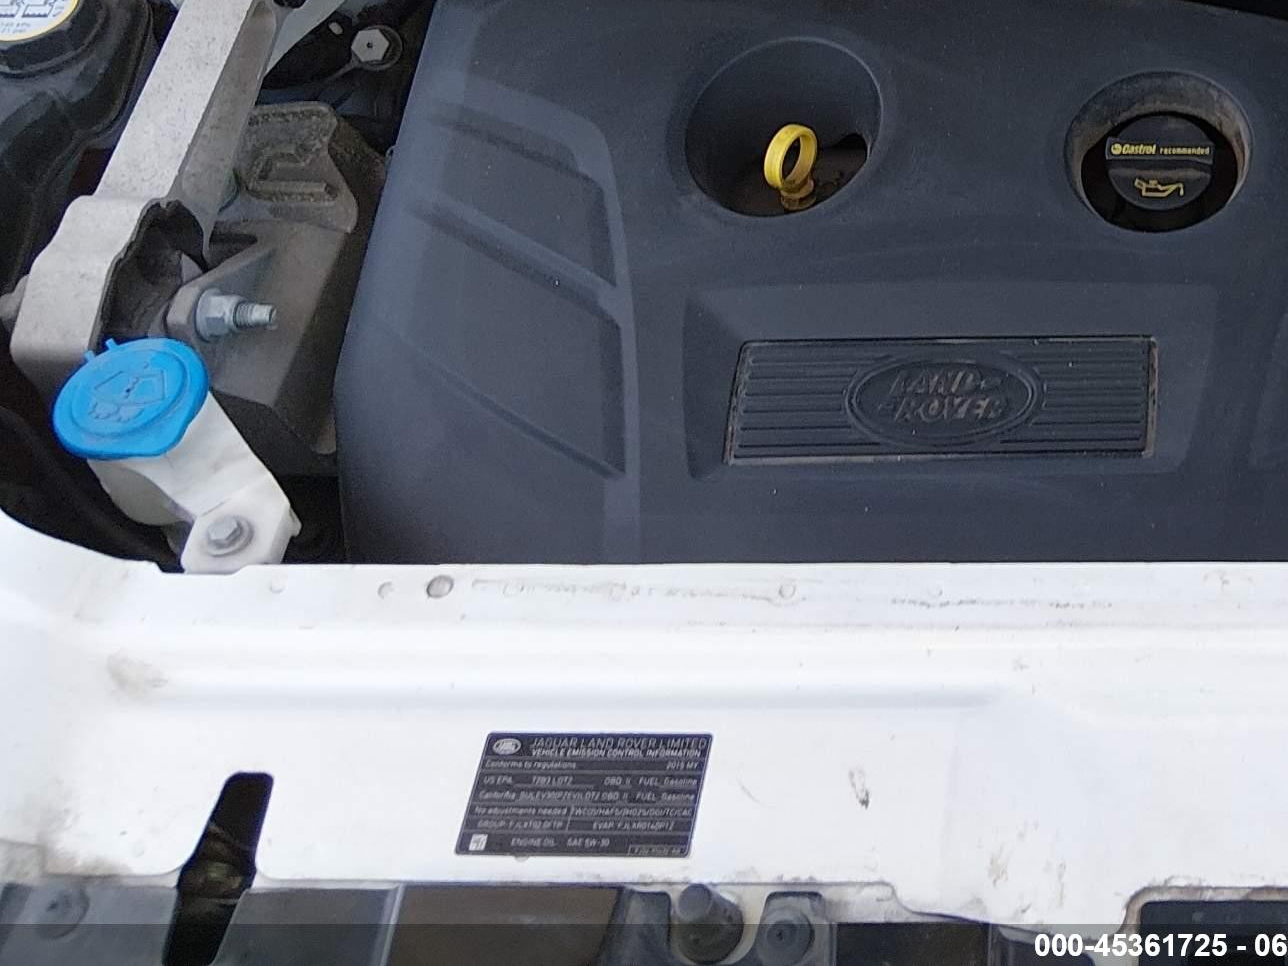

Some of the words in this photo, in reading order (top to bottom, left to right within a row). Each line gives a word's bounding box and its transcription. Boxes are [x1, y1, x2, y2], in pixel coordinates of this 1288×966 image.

[1122, 143, 1157, 156] Castrol
[530, 737, 578, 749] JAGUAR
[580, 737, 614, 749] LAND
[617, 737, 657, 749] ROVER
[659, 737, 707, 750] LIMITED
[532, 748, 565, 757] VEHICLE
[566, 748, 605, 758] EMISSION
[607, 748, 643, 758] CONTROL
[646, 748, 701, 758] INFORMATION
